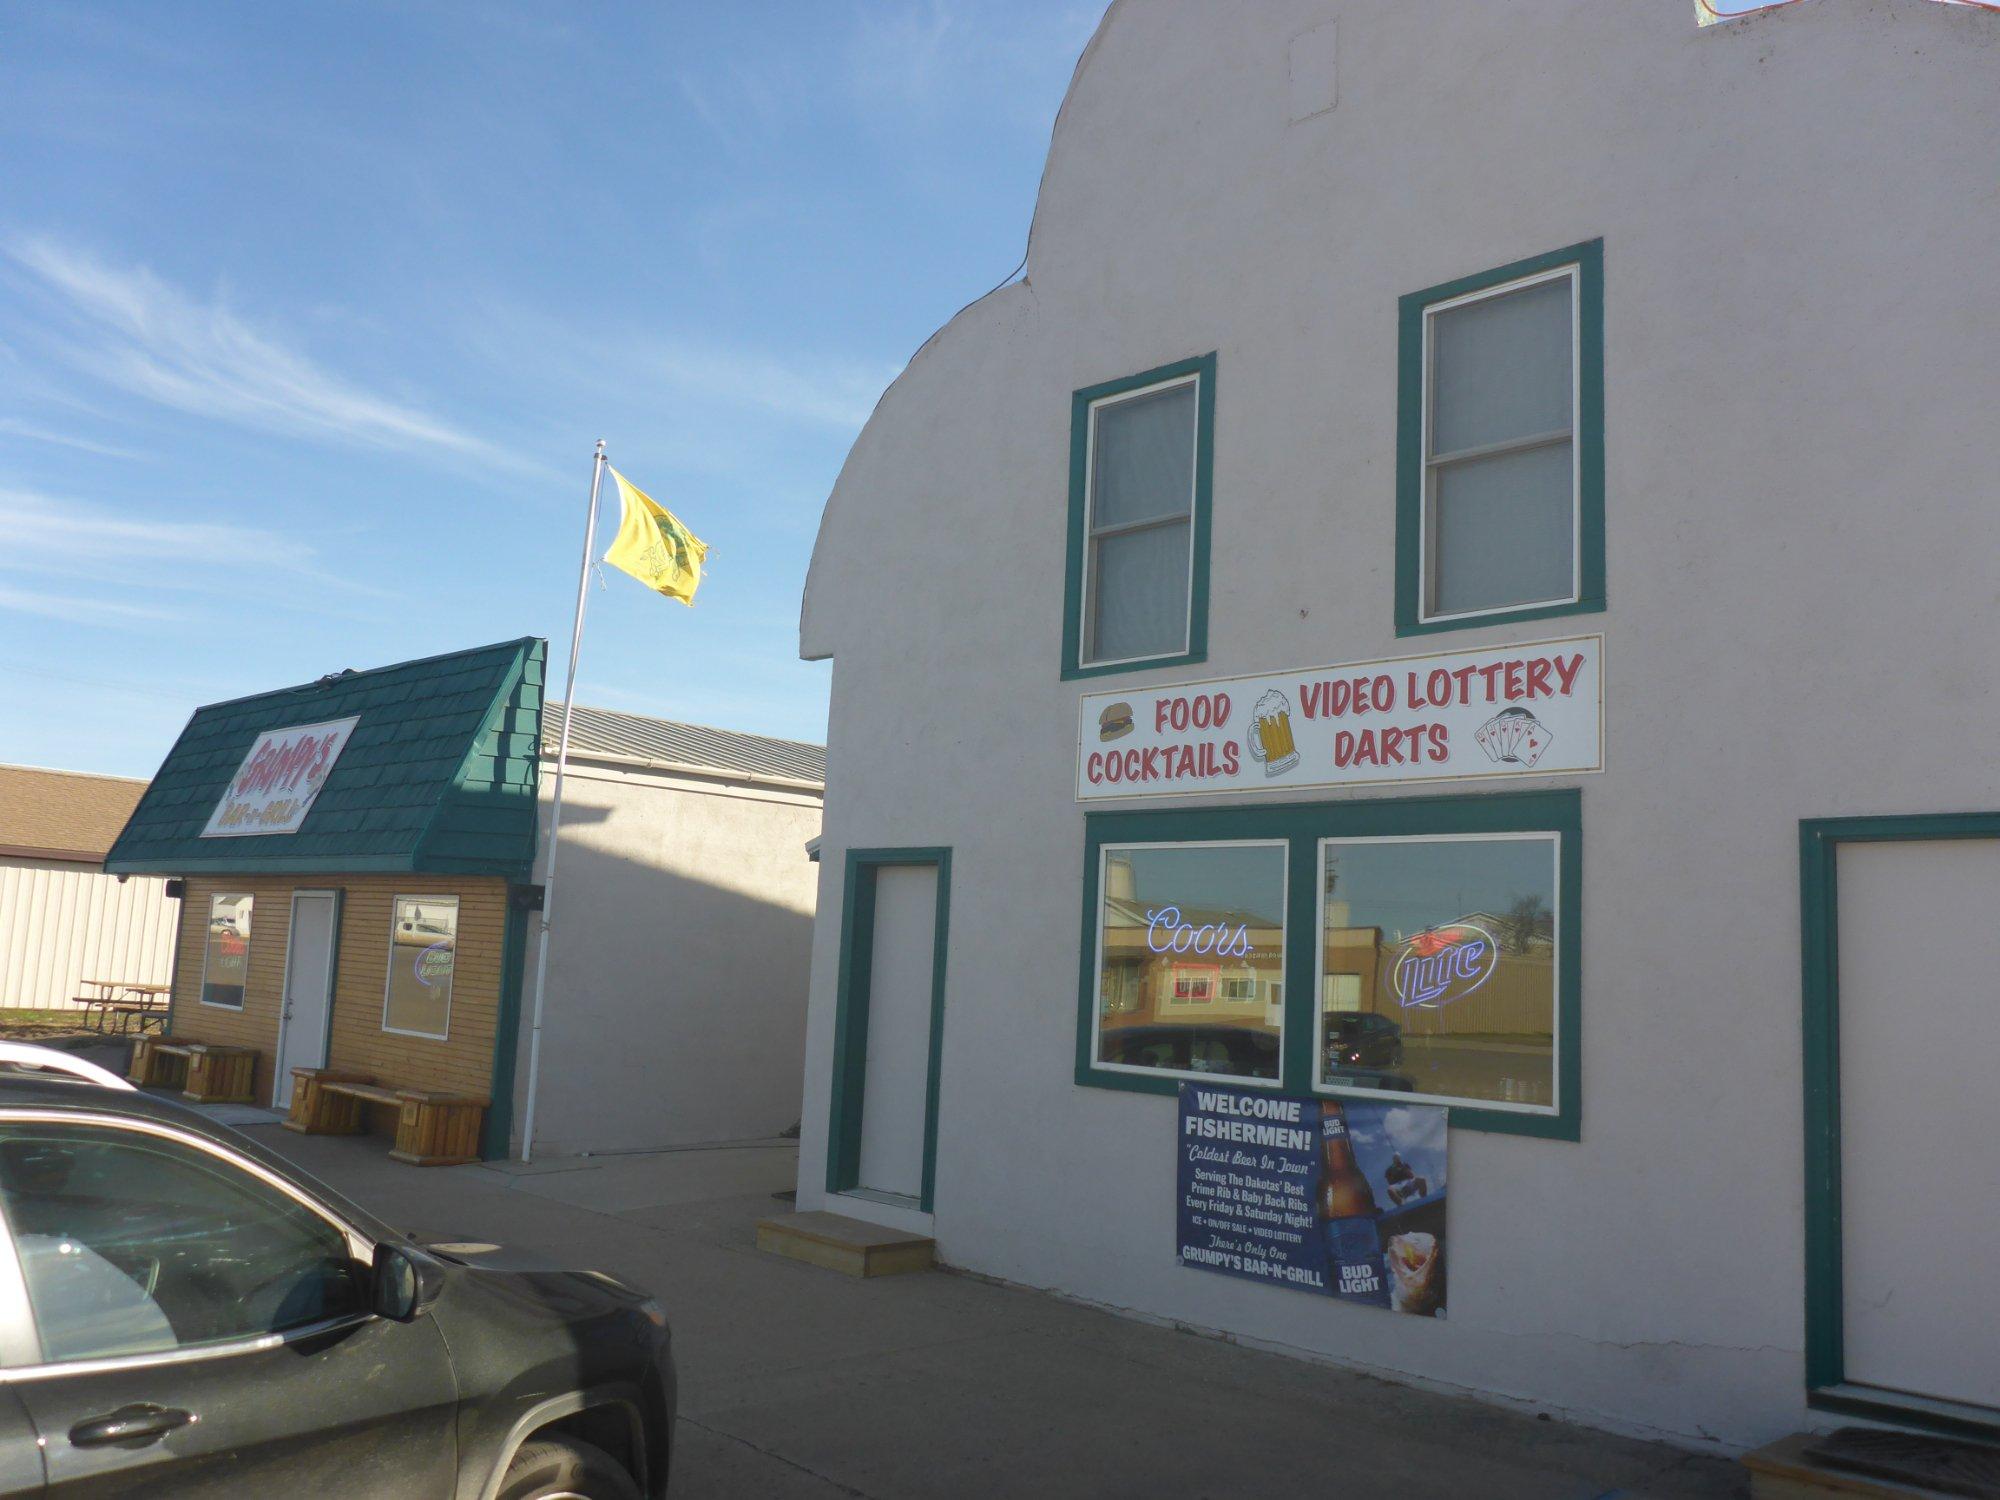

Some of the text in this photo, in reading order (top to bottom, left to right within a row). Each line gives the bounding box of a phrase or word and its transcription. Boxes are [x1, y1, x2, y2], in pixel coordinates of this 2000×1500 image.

[1300, 653, 1584, 720] VIDEO LOTTERY
[1155, 691, 1231, 735] FOOD
[1334, 722, 1449, 768] DARTS
[1087, 739, 1240, 784] COCKTAILS
[1147, 906, 1254, 958] Coors
[1197, 1091, 1301, 1122] WELCOME
[1185, 1115, 1312, 1151] FISHERMEN!
[1322, 1125, 1345, 1137] LIGHT
[1323, 1118, 1341, 1128] BUD
[1232, 1150, 1257, 1167] Beer
[1260, 1154, 1275, 1169] In
[1191, 1181, 1308, 1212] Prime Rib & Baby Back Ribs
[1195, 1167, 1226, 1185] Serving
[1228, 1172, 1244, 1185] The
[1284, 1181, 1305, 1197] Best
[1186, 1195, 1313, 1229] Every Friday & Saturday Night!
[1192, 1215, 1203, 1225] ICE
[1231, 1222, 1248, 1234] SALE
[1253, 1226, 1273, 1238] VIDEO
[1274, 1231, 1303, 1244] LOTTERY
[1208, 1234, 1288, 1261] There's Only One
[1182, 1245, 1324, 1287] GRUMPY'S BAR-N-GRILL
[1341, 1264, 1373, 1280] BUD
[1339, 1276, 1380, 1294] LIGHT
